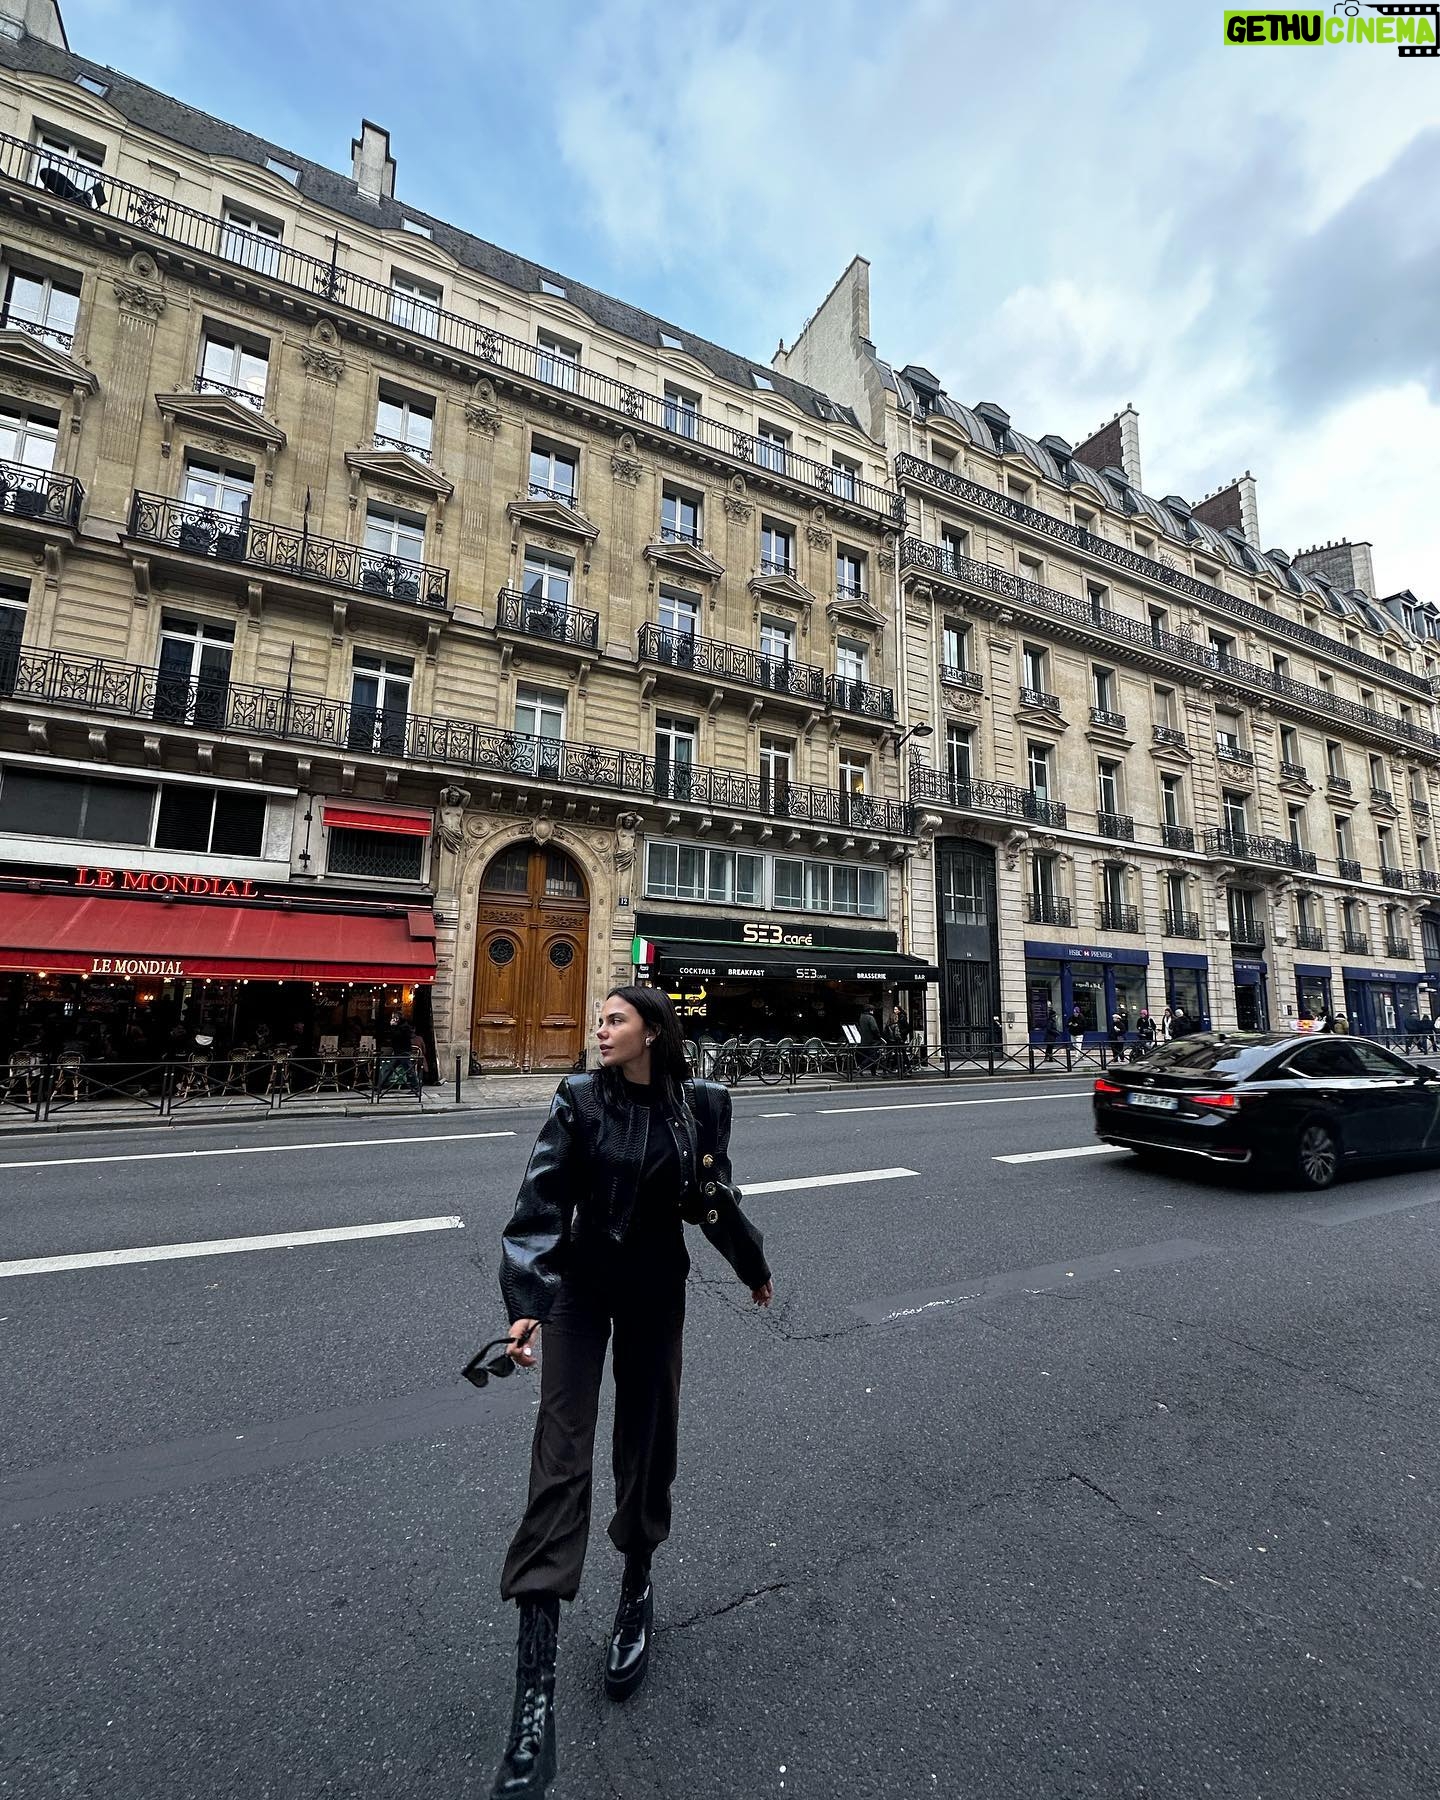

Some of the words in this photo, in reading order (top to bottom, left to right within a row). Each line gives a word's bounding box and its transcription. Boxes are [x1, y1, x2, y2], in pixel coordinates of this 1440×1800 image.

[75, 867, 114, 888] LE
[121, 871, 259, 898] MONDIAL
[783, 933, 813, 946] café
[1068, 949, 1083, 957] HSBC
[1090, 950, 1113, 959] PREMIER
[92, 958, 111, 973] LE
[114, 959, 183, 975] MONDIAL
[679, 967, 716, 975] COCKTAILS
[728, 968, 765, 977] BREAKFAST
[856, 972, 887, 980] BRASSERIE
